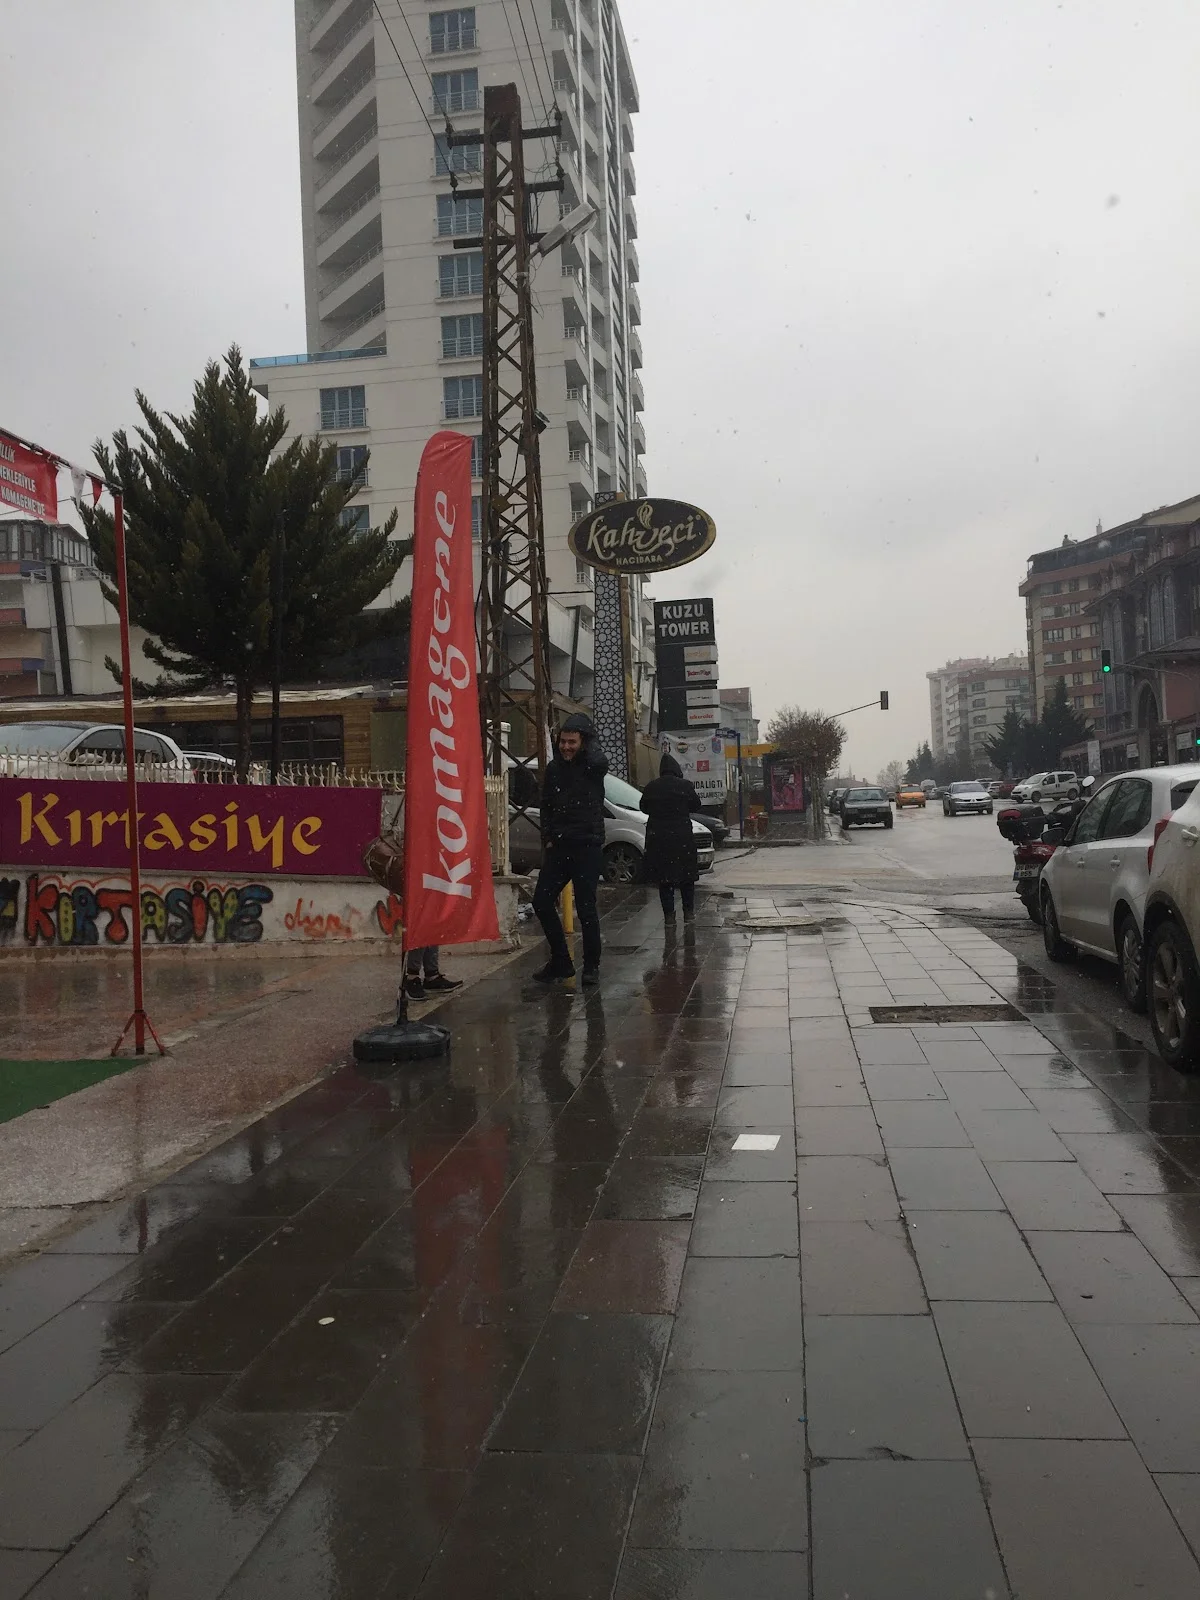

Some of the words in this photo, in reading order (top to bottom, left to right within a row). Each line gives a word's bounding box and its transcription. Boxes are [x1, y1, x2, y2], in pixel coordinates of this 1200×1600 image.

[1, 485, 46, 516] KOMAGENE'DE
[586, 514, 697, 561] Kahveci
[659, 620, 710, 638] TOWER
[662, 603, 705, 620] KUZU
[422, 489, 472, 901] komagene
[16, 791, 323, 869] Kırtasiye
